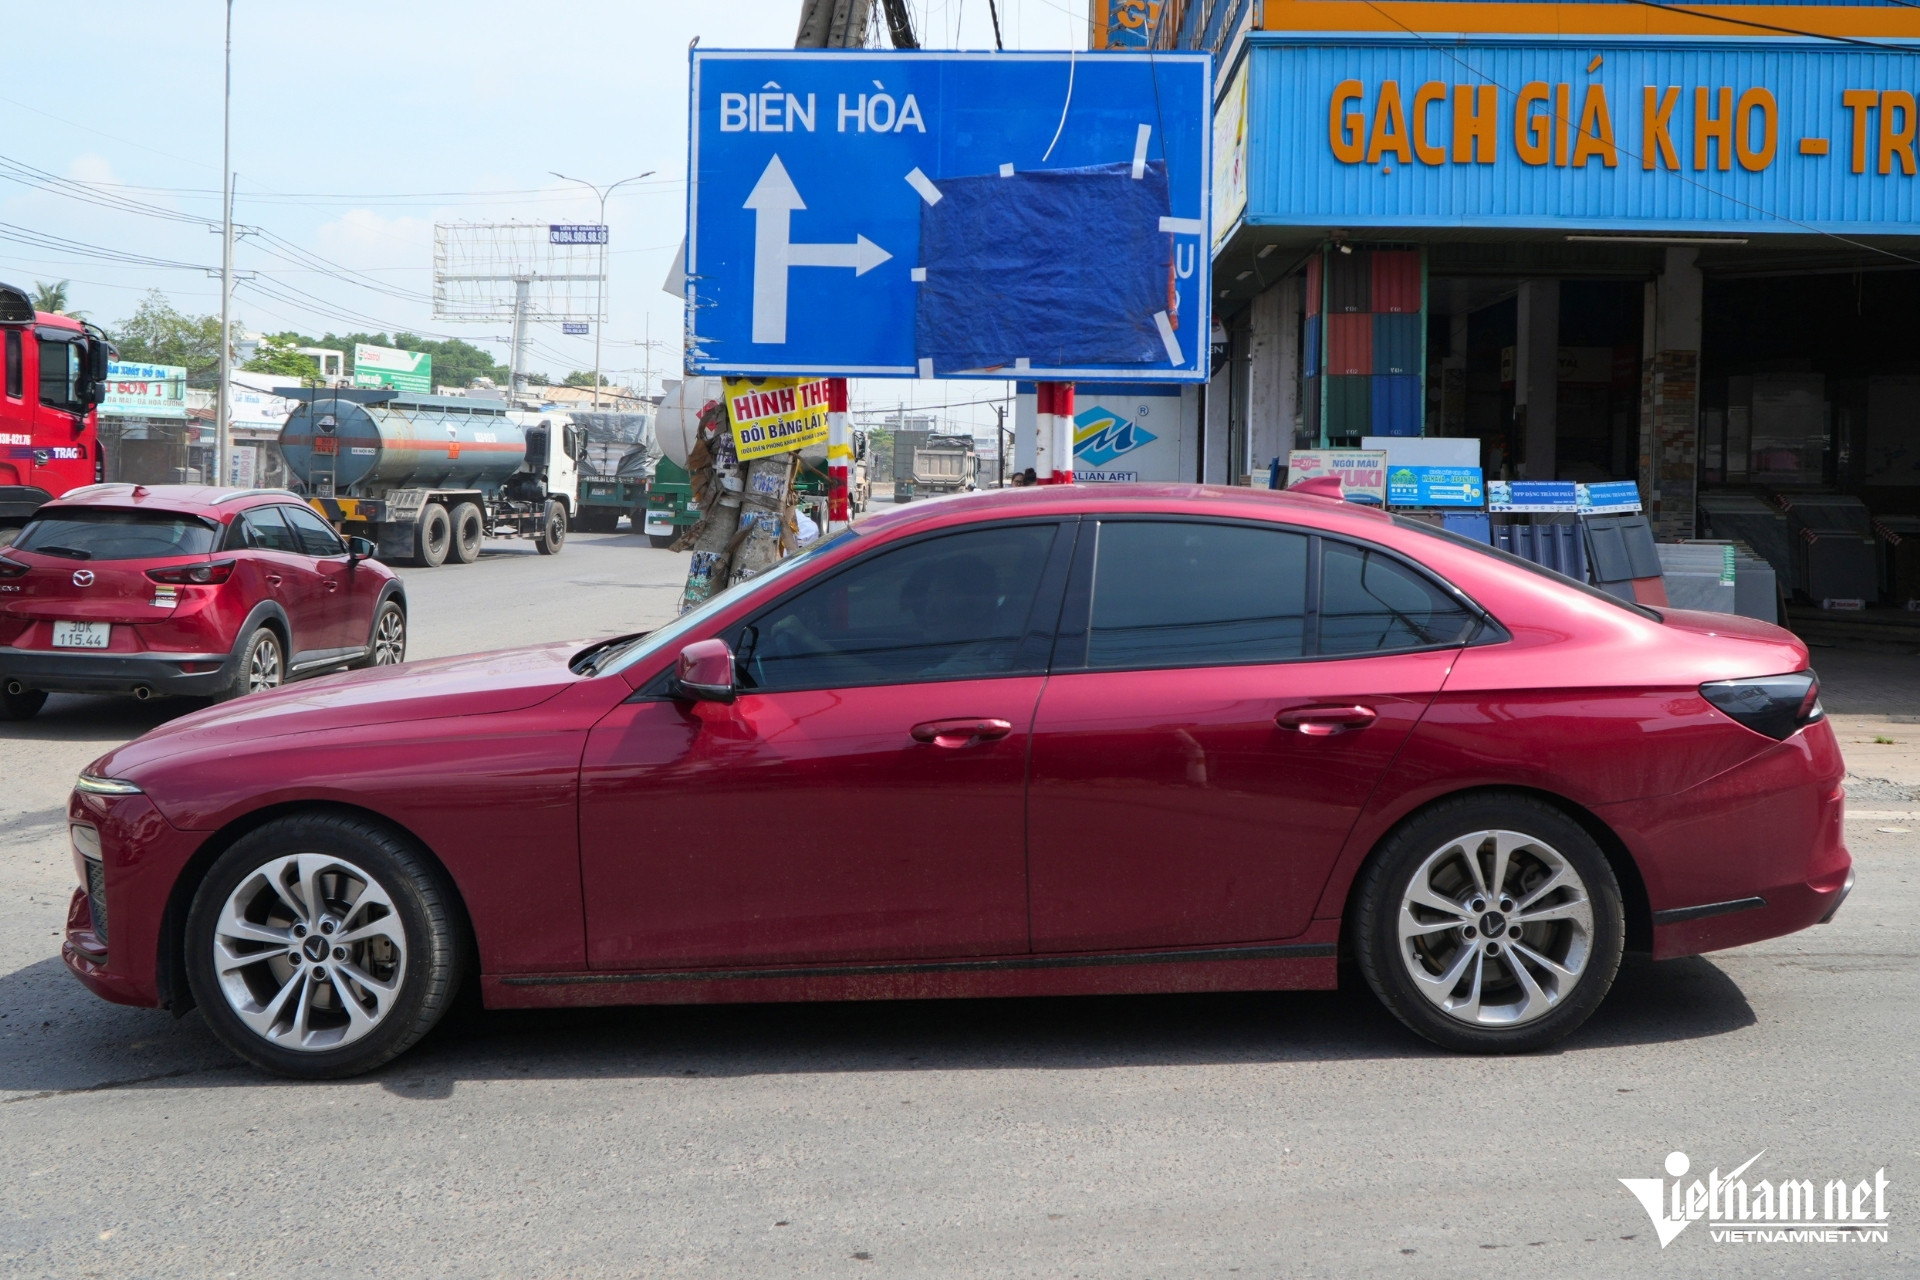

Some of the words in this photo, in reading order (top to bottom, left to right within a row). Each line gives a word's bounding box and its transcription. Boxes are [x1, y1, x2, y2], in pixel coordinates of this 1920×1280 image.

[720, 80, 816, 134] BIÊN
[836, 80, 927, 134] HÒA
[1329, 78, 1497, 175] GẠCH
[1514, 54, 1619, 169] GIÁ
[1843, 89, 1920, 176] TR
[1174, 243, 1195, 279] U
[733, 387, 797, 421] HÌNH
[804, 411, 821, 431] LÁI
[1072, 472, 1105, 480] ALIAN
[1109, 472, 1133, 481] ART
[59, 633, 102, 647] 115.44
[69, 621, 93, 633] 30K
